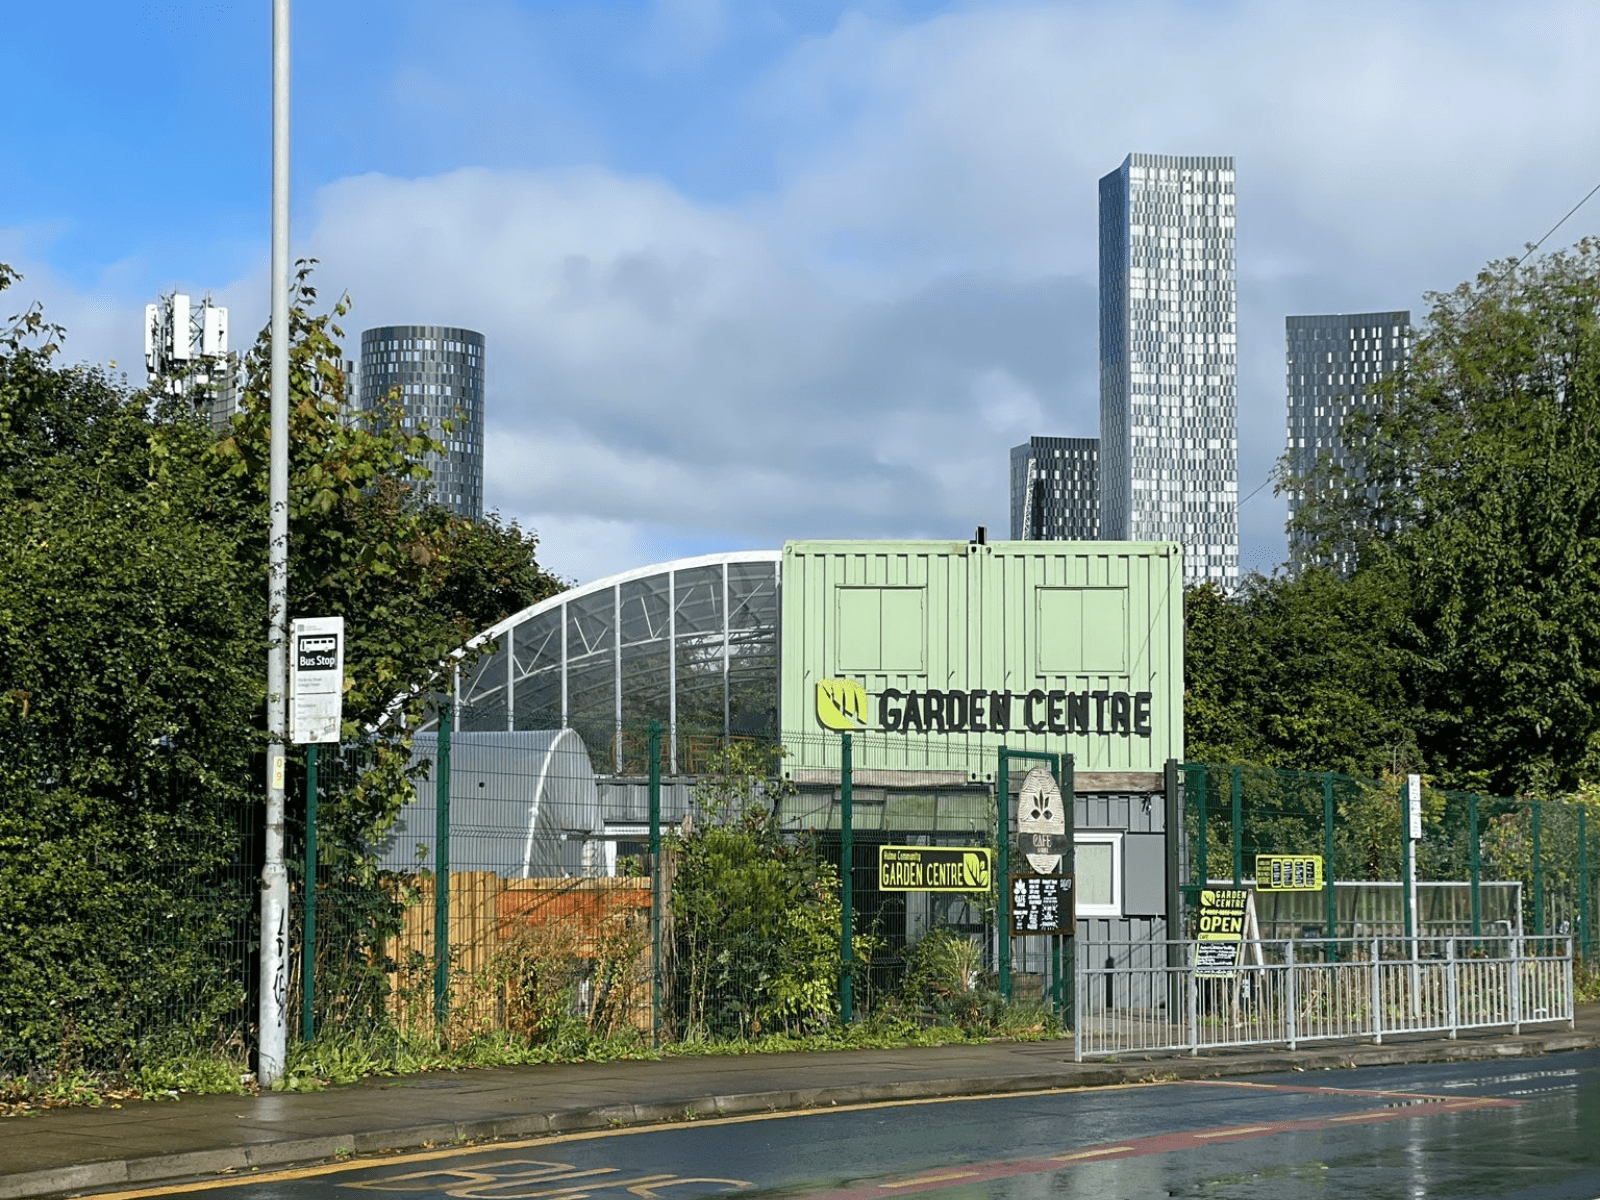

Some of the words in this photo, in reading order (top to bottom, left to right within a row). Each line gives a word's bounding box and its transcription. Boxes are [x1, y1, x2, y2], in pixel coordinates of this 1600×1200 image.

[300, 656, 315, 667] Bus
[316, 655, 336, 668] Stop
[879, 688, 1012, 734] GARDEN
[1024, 689, 1153, 736] CENTRE
[883, 862, 923, 886] GARDEN
[926, 862, 964, 886] CENTRE
[1215, 890, 1247, 899] GARDEN
[1215, 899, 1245, 908] CENTRE
[1200, 916, 1243, 932] OPEN
